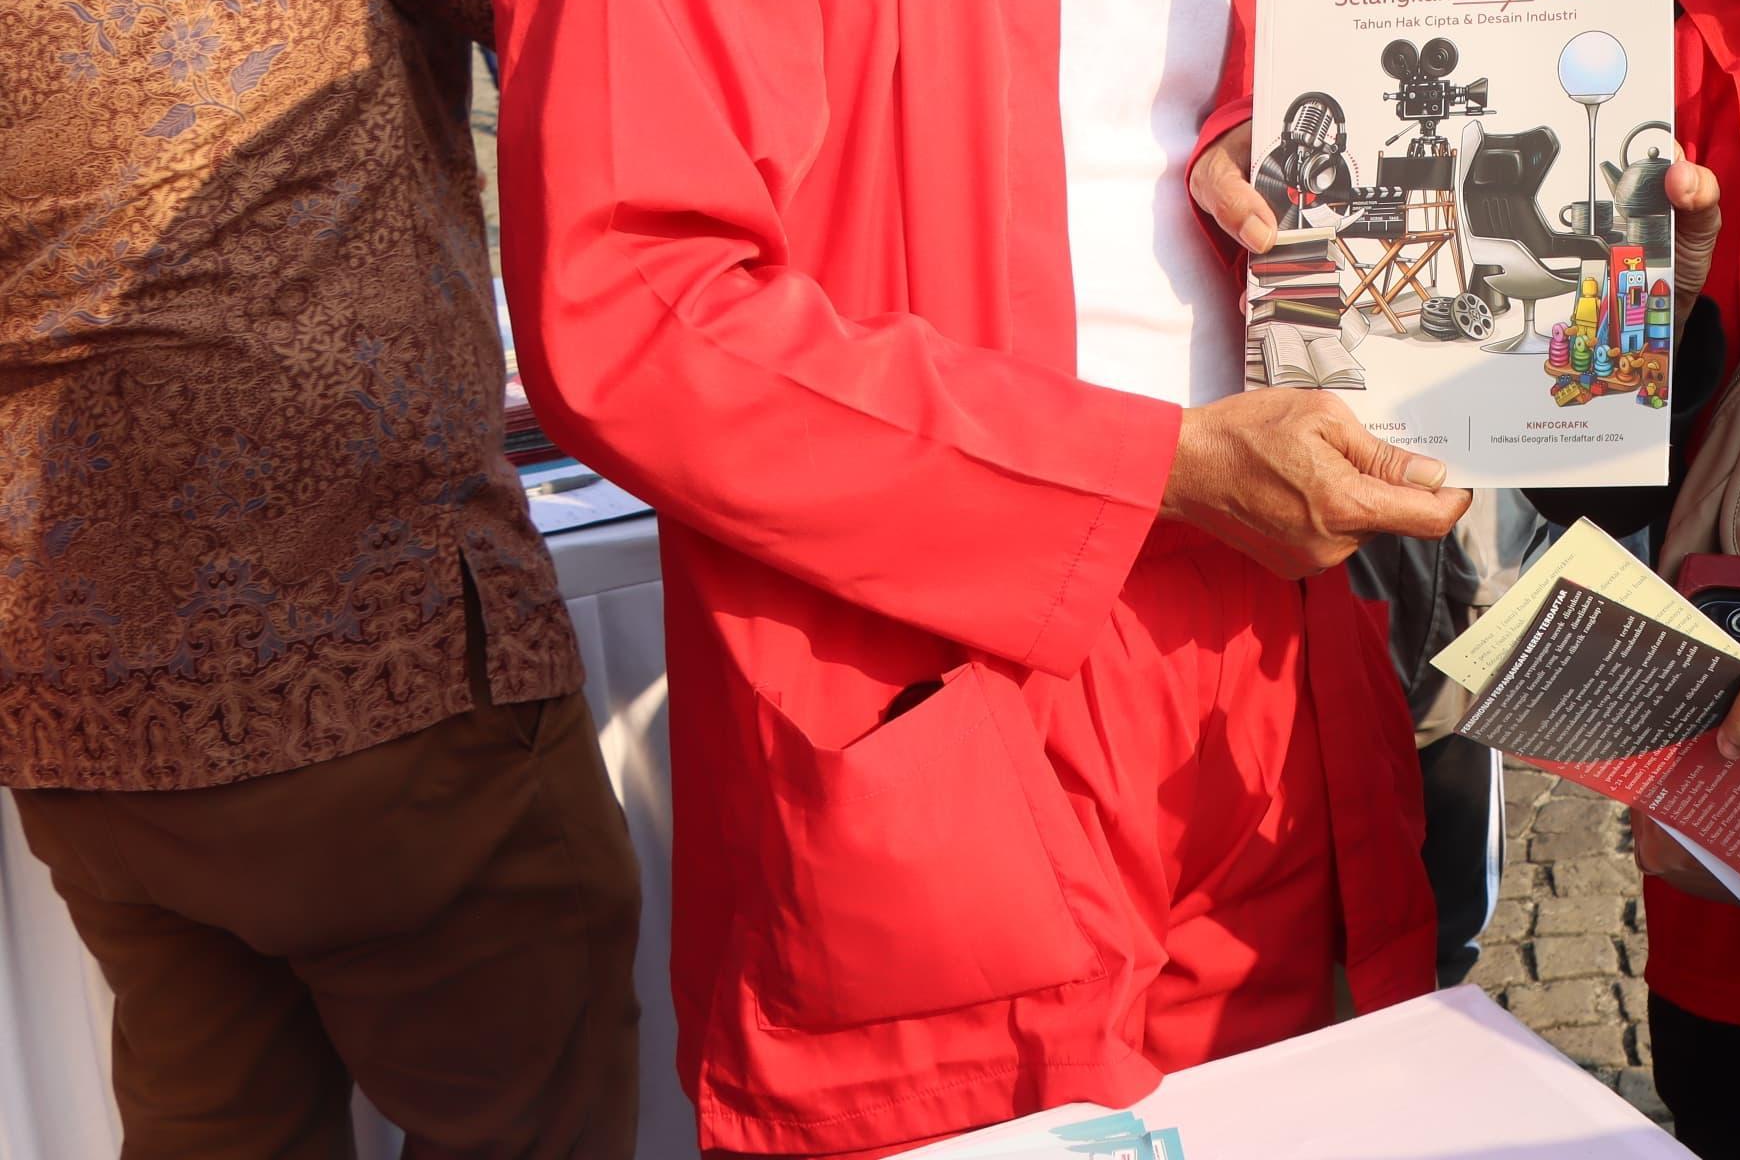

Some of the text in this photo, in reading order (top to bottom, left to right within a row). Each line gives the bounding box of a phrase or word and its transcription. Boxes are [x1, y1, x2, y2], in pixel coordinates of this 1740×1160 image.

[1353, 9, 1577, 30] Tahun Hak Cipta & Desain Industri
[1369, 422, 1407, 431] KHUSUS
[1490, 434, 1520, 443] Indikasi
[1521, 434, 1559, 444] Geografis
[1560, 433, 1595, 442] Terdaftar
[1561, 589, 1583, 620] diajukan
[1581, 606, 1602, 634] rangkap
[1618, 614, 1635, 637] terkait
[1459, 696, 1495, 733] PERMOHONAN
[1490, 652, 1529, 698] PERPANJANGAN
[1523, 629, 1544, 653] MEREK
[1538, 588, 1567, 631] TERDAFTAR
[1706, 654, 1721, 672] pada
[1647, 787, 1669, 810] SYARAT
